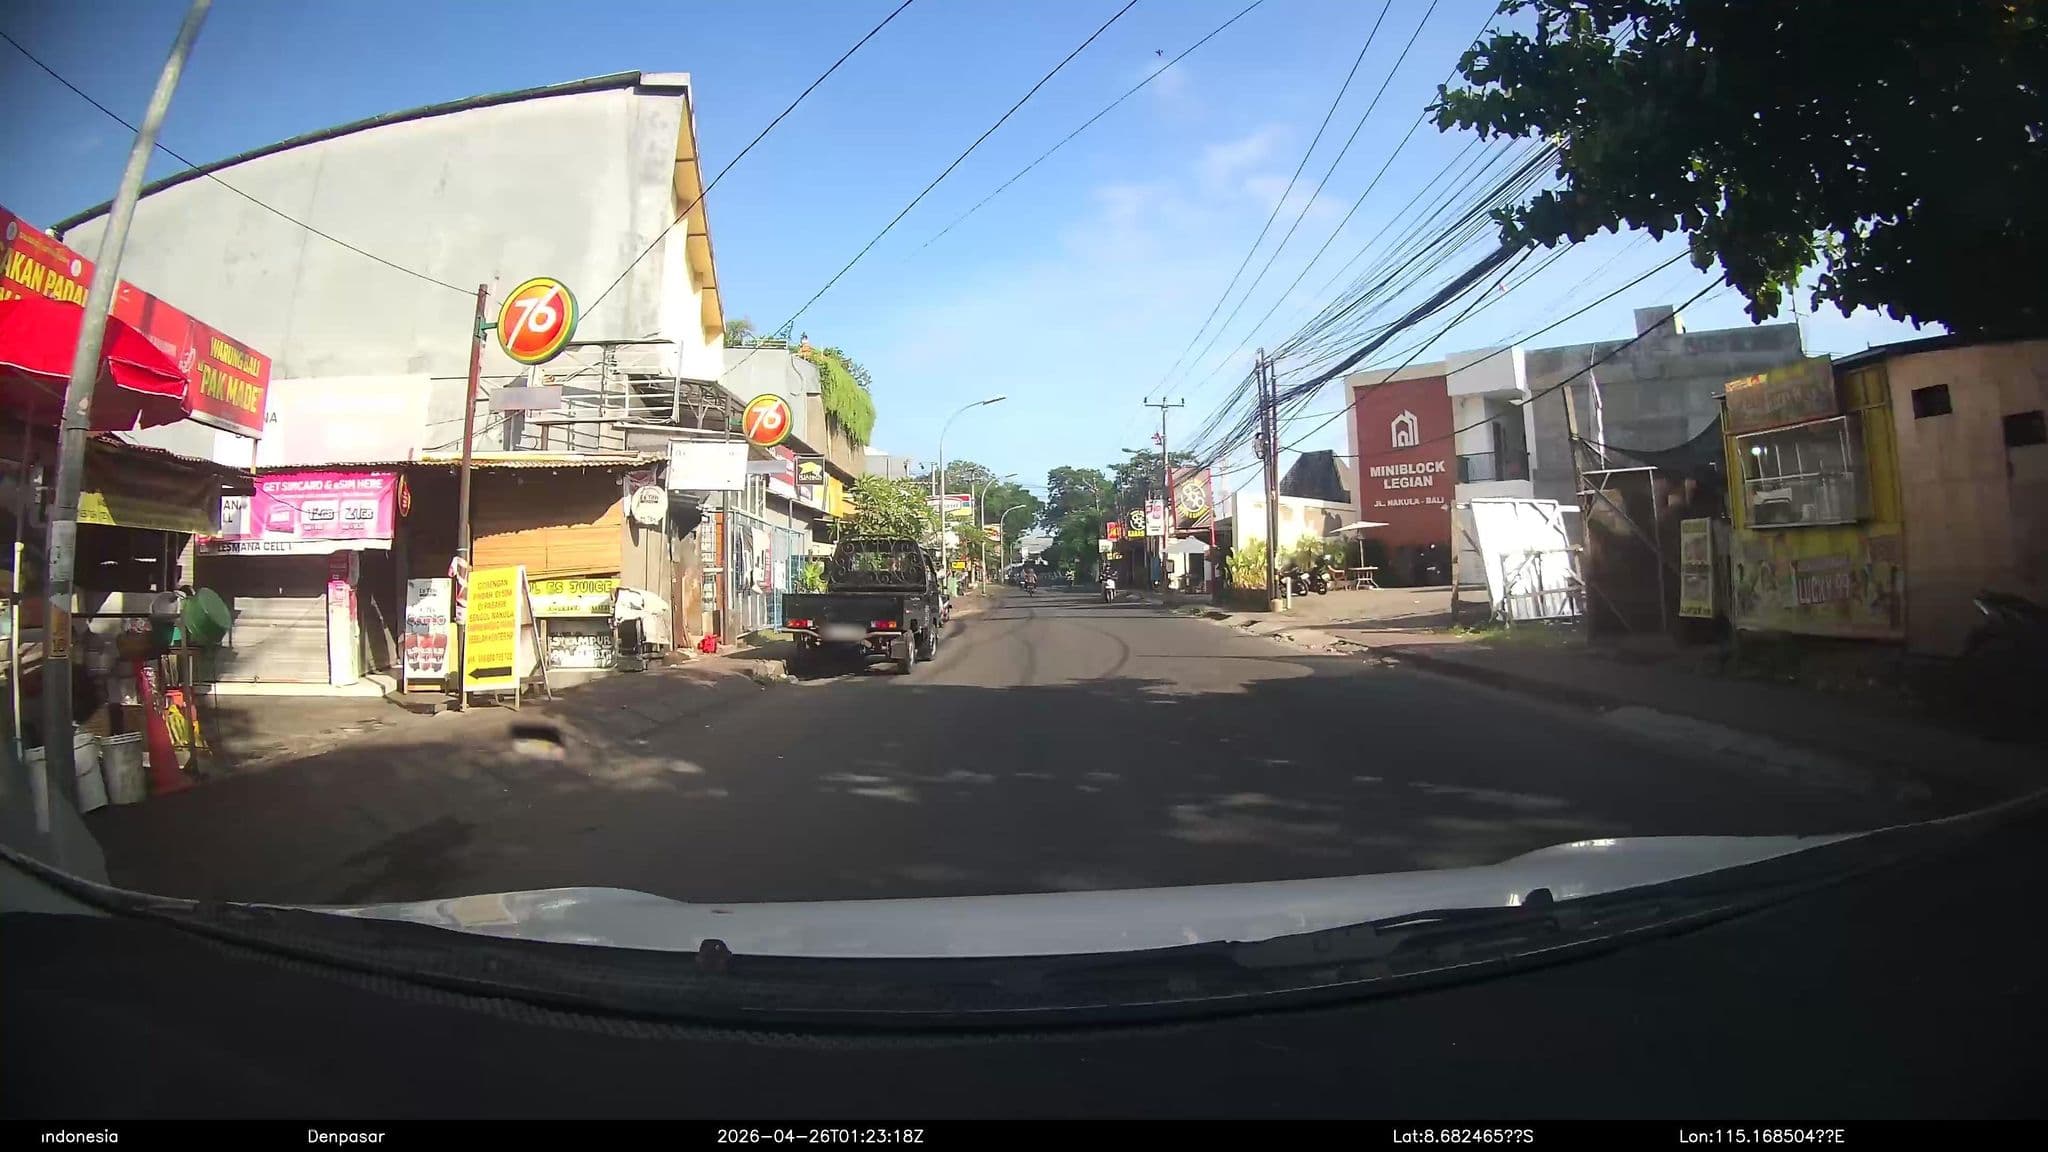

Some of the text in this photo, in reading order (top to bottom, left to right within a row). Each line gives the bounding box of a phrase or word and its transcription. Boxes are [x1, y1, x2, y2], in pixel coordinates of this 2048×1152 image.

[507, 284, 561, 351] 76
[750, 399, 783, 439] 76
[1370, 460, 1446, 477] MINIBLOCK
[263, 481, 281, 492] GET
[357, 478, 383, 489] HERE
[1383, 475, 1433, 490] LEGIAN
[1387, 498, 1420, 506] NAKULA
[1425, 496, 1444, 504] BALI
[217, 541, 261, 552] LESMANA
[263, 541, 285, 551] CELL
[570, 580, 613, 594] JUICE
